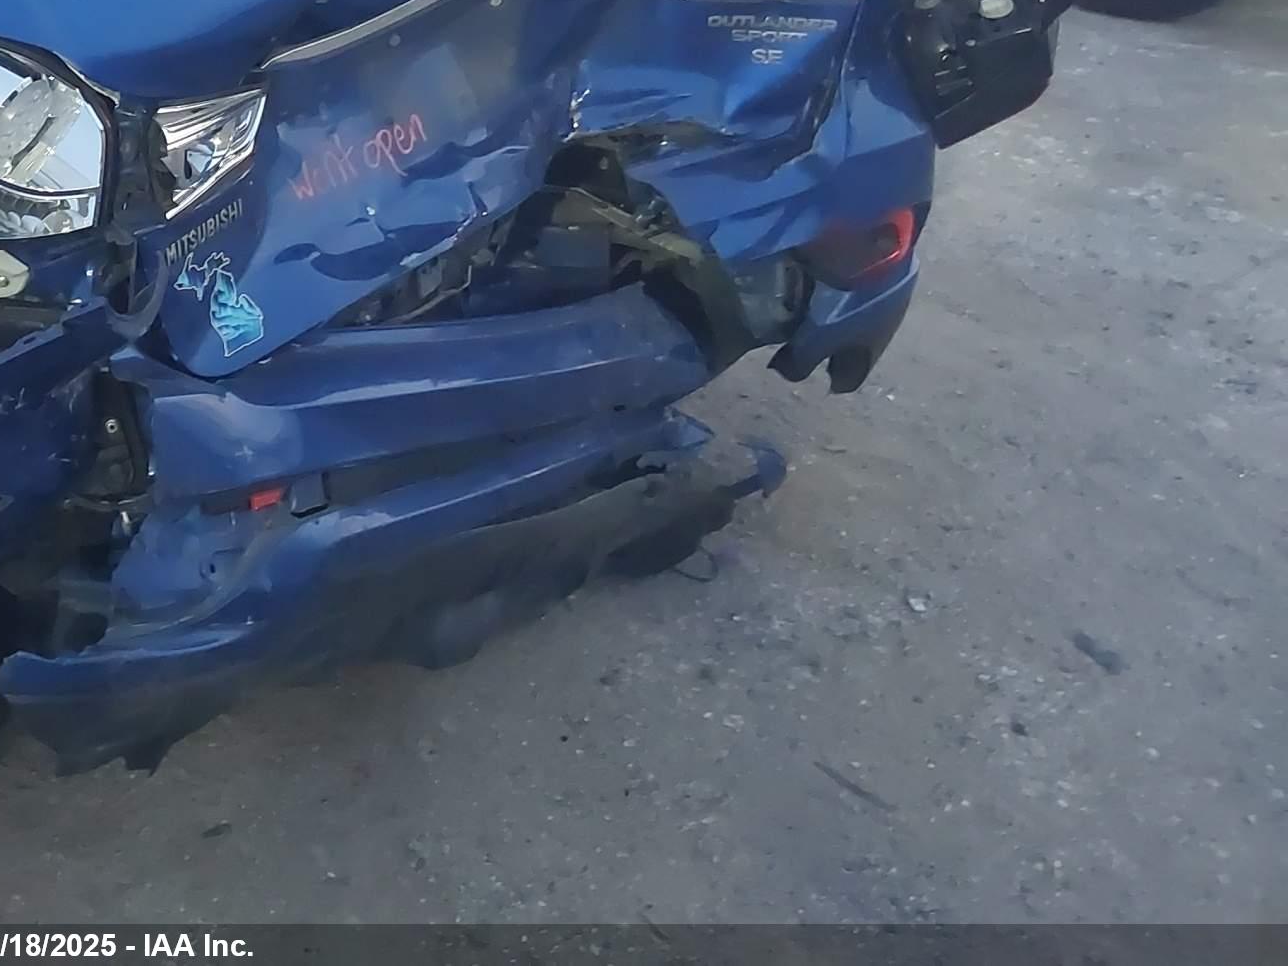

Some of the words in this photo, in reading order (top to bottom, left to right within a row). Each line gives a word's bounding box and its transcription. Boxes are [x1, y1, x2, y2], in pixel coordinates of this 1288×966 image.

[707, 15, 838, 32] OUTLANDER
[731, 29, 808, 43] SPORT
[751, 48, 784, 65] SE
[363, 113, 428, 177] open
[165, 197, 243, 267] MITSUBISHI
